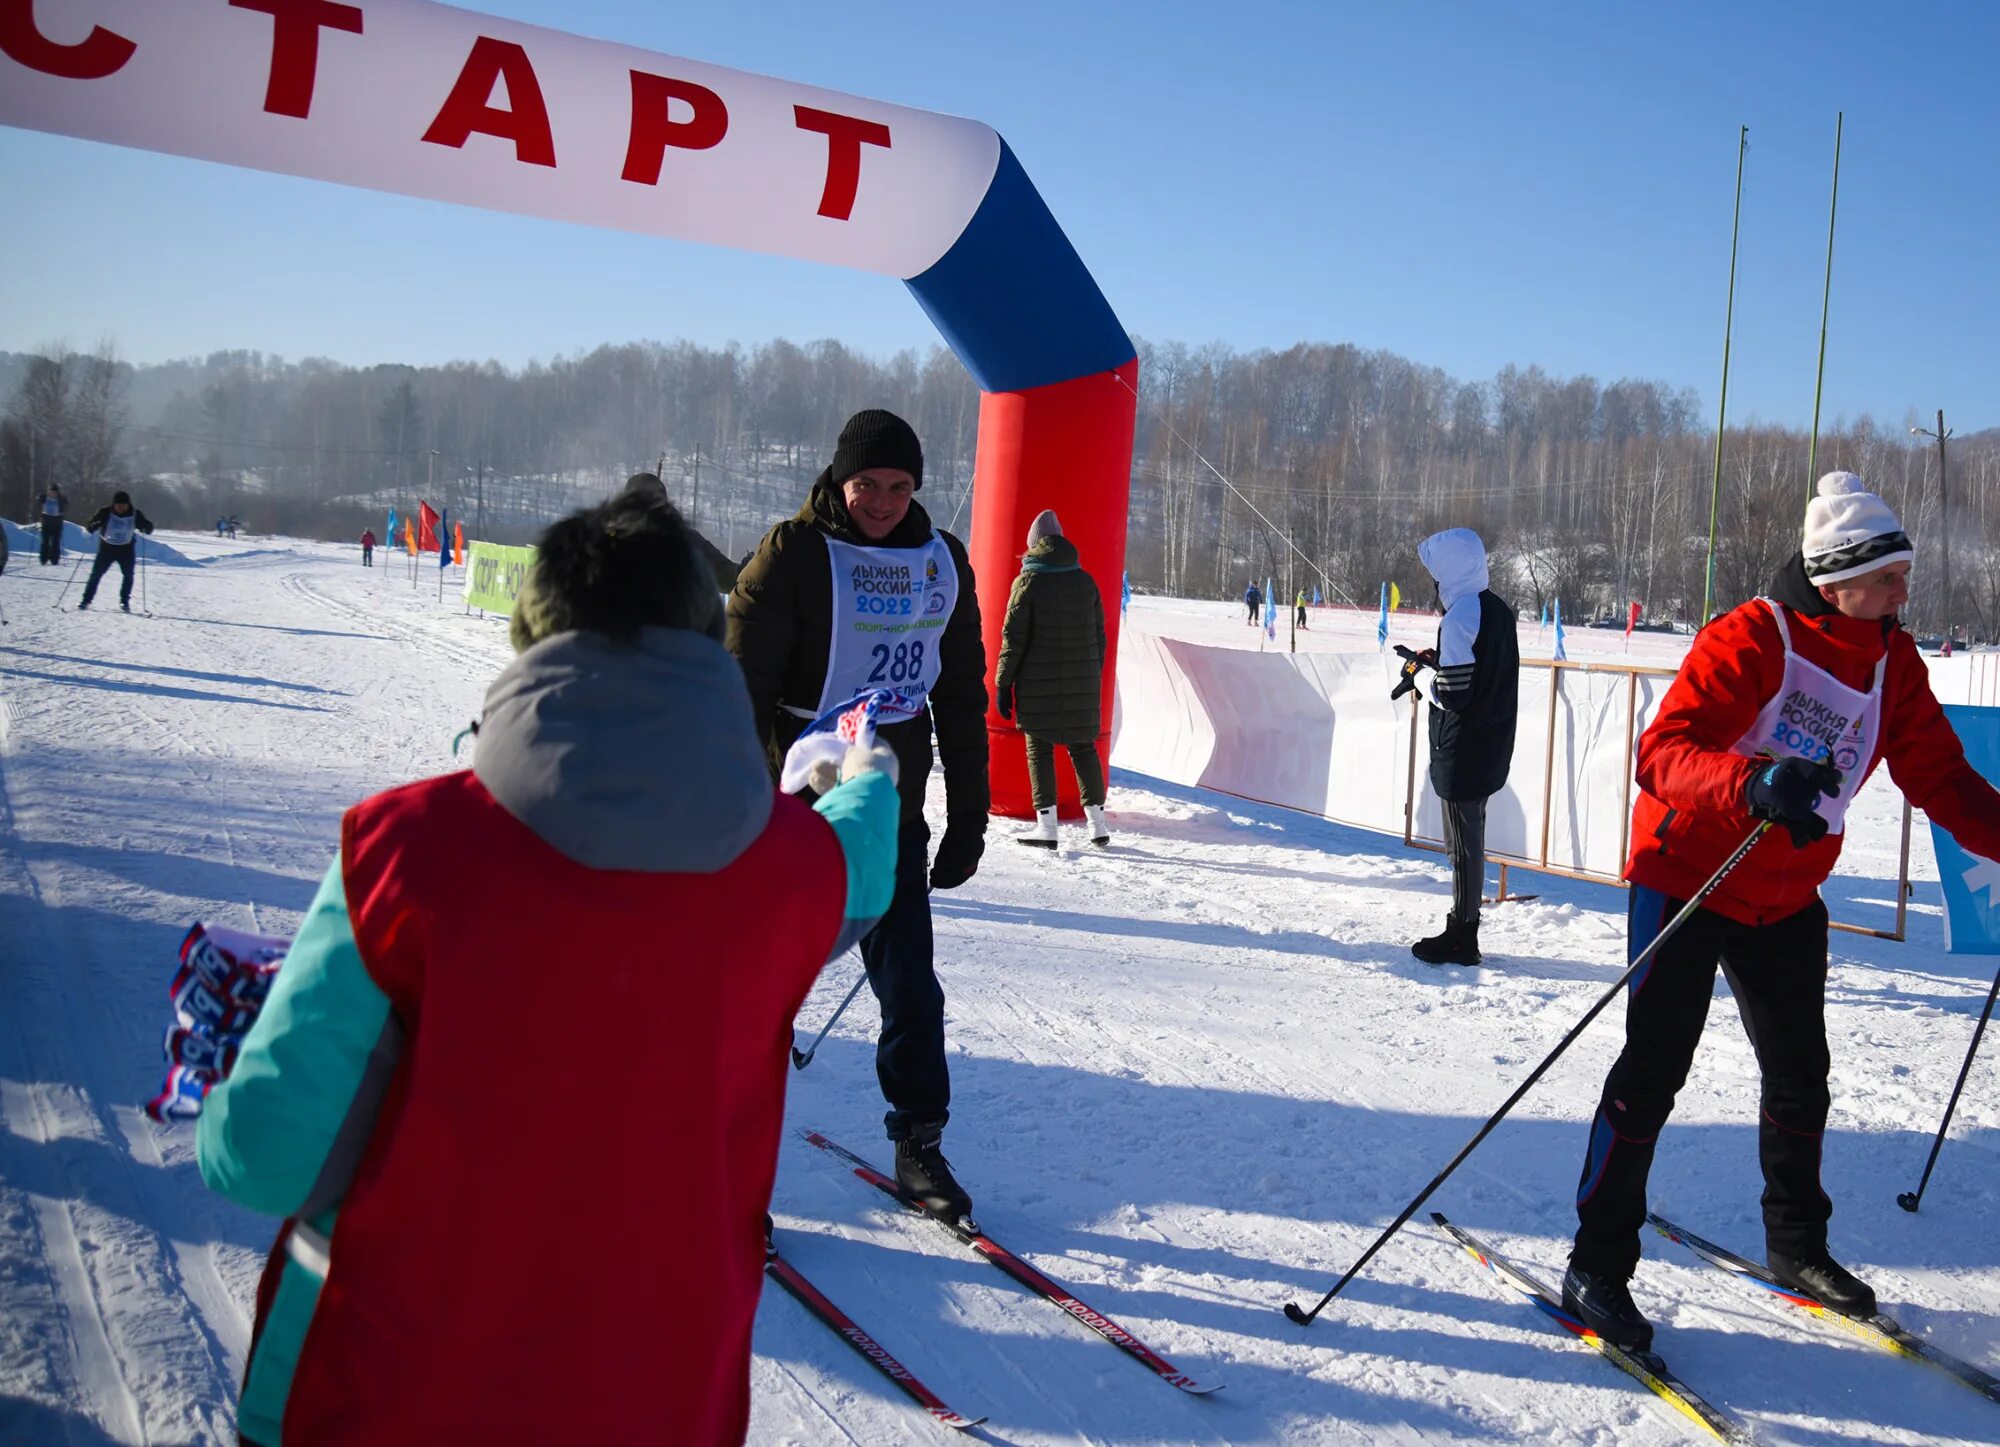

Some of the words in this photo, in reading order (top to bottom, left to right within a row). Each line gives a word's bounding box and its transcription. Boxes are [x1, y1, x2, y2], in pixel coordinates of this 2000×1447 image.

[0, 0, 891, 221] СТАРТ
[851, 565, 910, 579] ЛЫЖНЯ
[853, 579, 911, 595] РОССИИ
[856, 595, 911, 615] 2022
[867, 640, 924, 682] 288
[1780, 702, 1841, 748] РОССИИ
[1785, 690, 1849, 732] ЛЫЖНЯ
[1771, 722, 1829, 761] 2022
[1060, 1299, 1139, 1346] NORDWAY
[1822, 1308, 1888, 1348] salomon
[842, 1327, 912, 1380] NORDWAY
